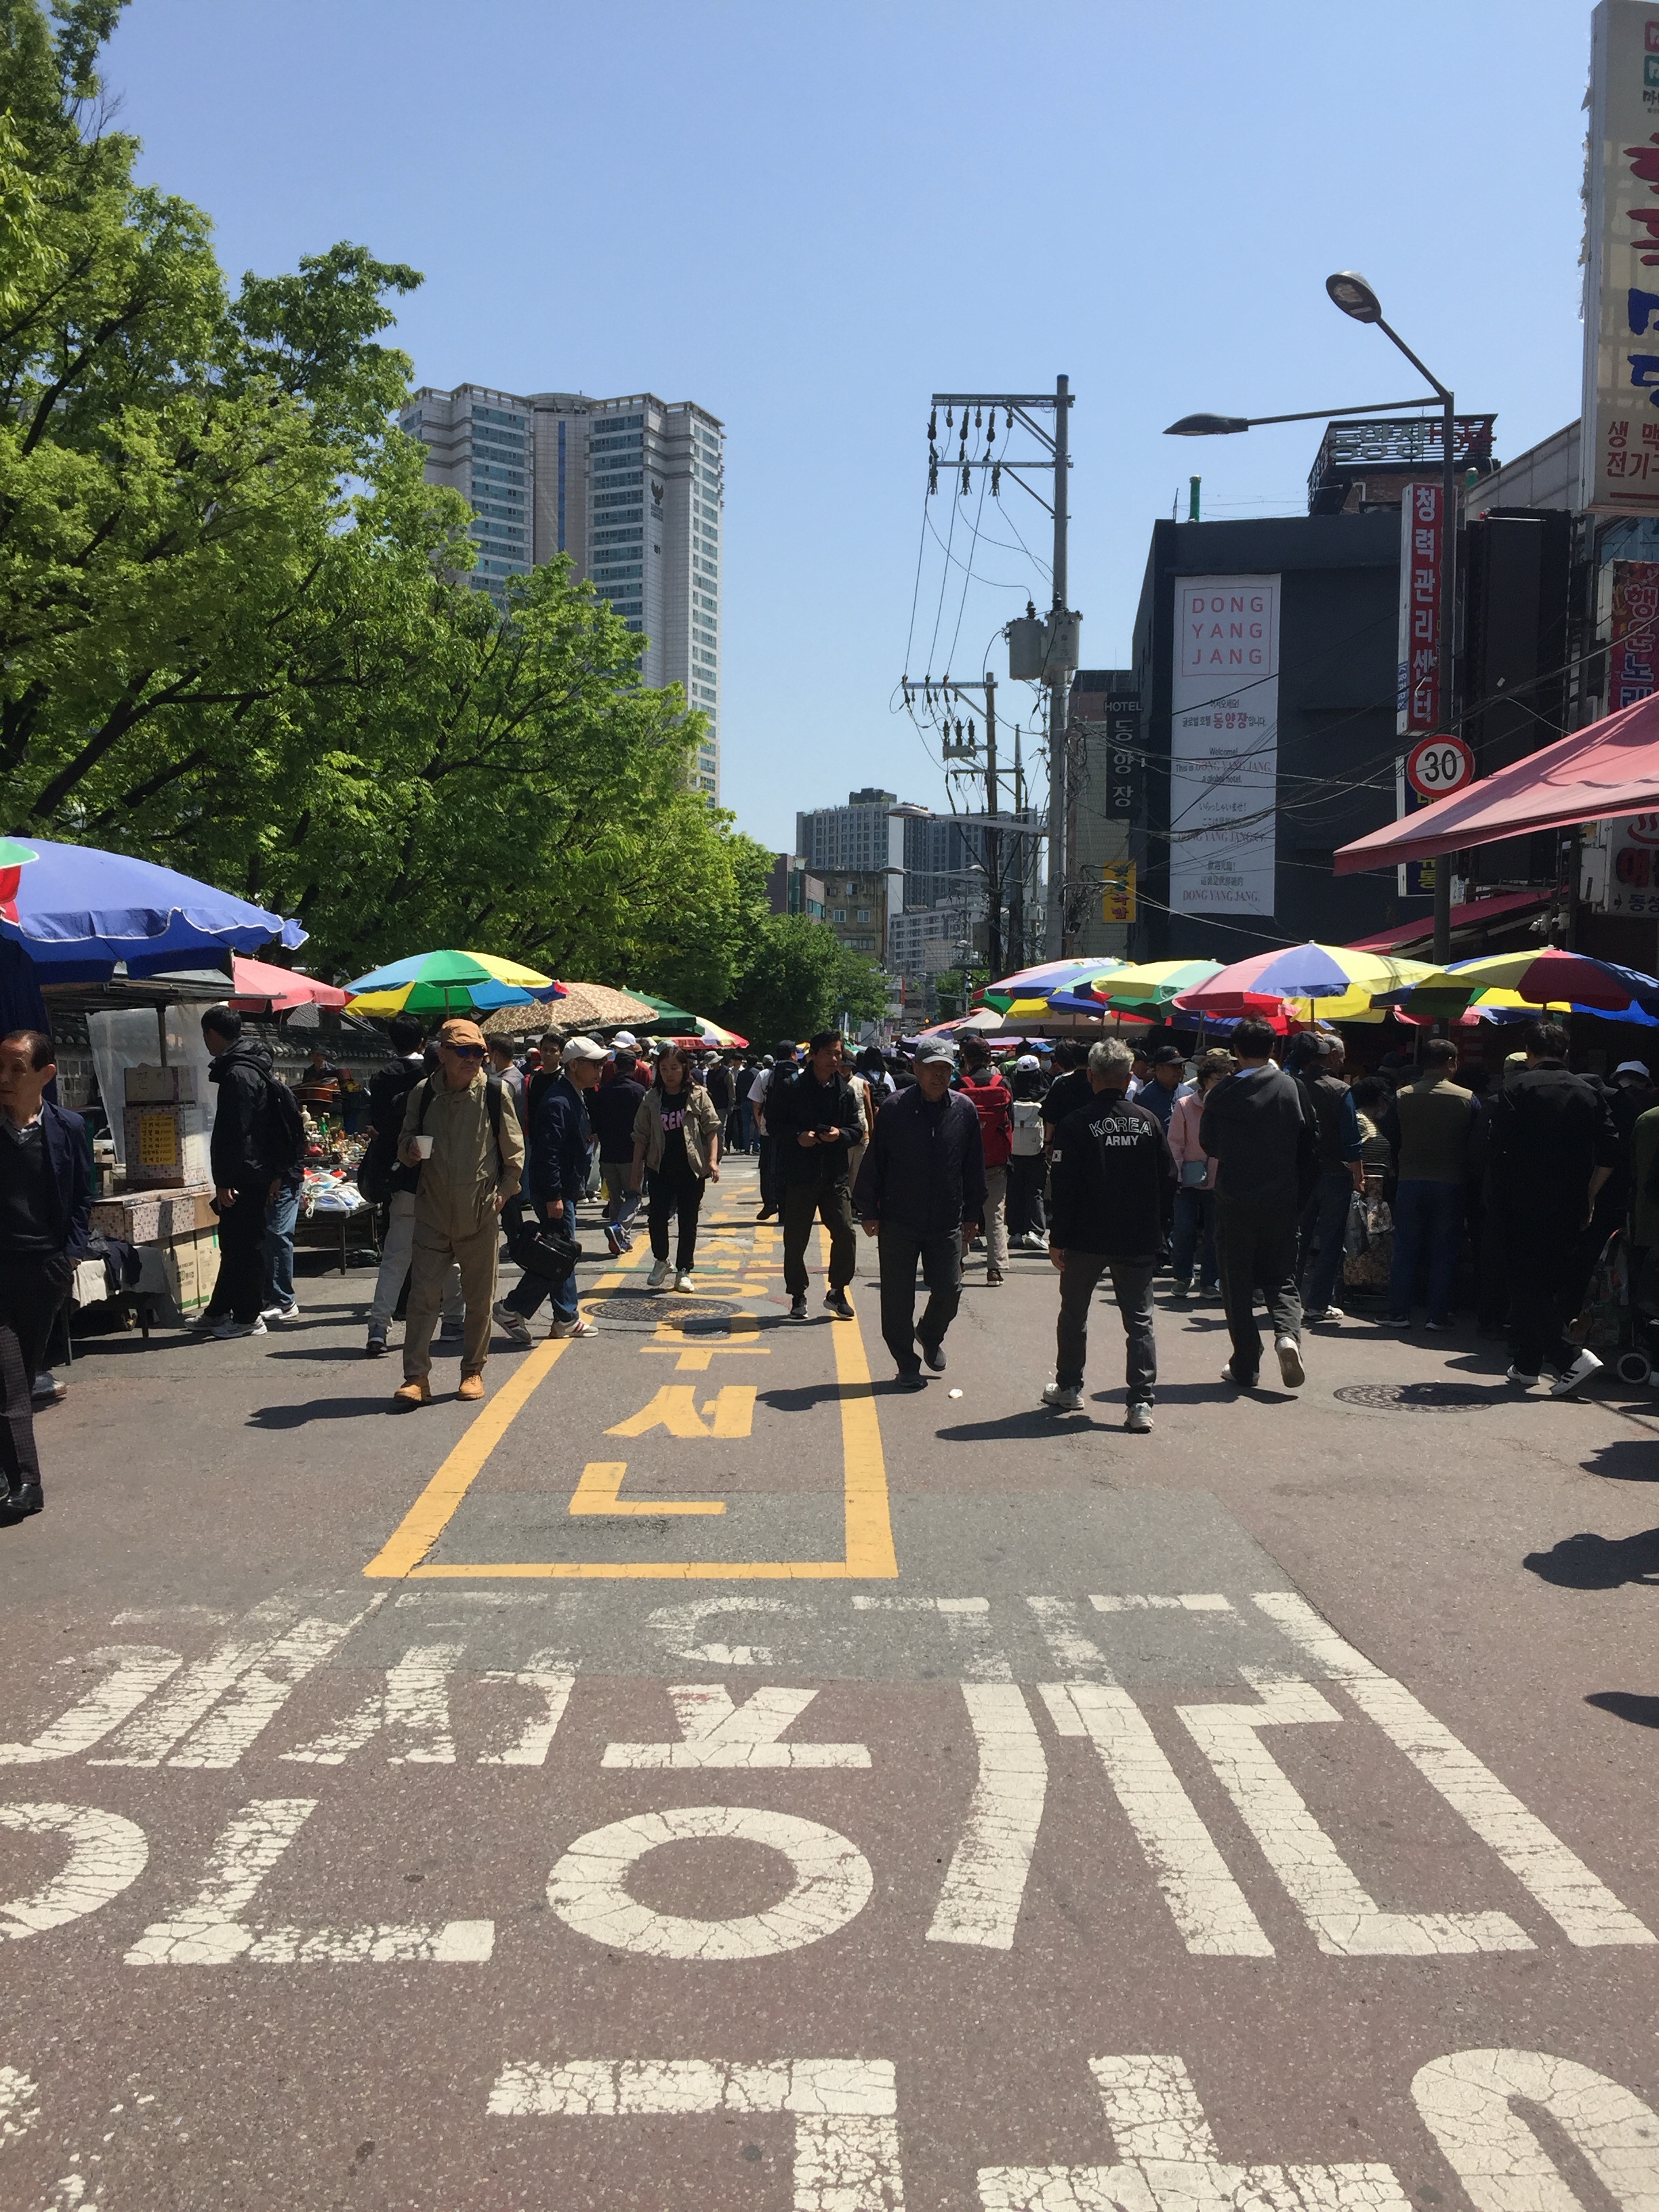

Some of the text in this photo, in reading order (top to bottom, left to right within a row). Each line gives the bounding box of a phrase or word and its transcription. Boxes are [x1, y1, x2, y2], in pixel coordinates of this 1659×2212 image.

[1328, 422, 1430, 462] 동양장
[1192, 596, 1263, 614] DONG
[1413, 487, 1435, 722] 청력관리센터
[1192, 622, 1263, 639] YANG
[1192, 648, 1262, 665] JANG
[1104, 701, 1143, 712] HOTEL
[1182, 716, 1199, 727] 글로벌
[1200, 715, 1211, 727] 호텔
[1209, 747, 1238, 756] Welcome!
[1112, 719, 1134, 807] 동양장
[1176, 764, 1188, 773] This
[1425, 750, 1457, 783] 30
[1616, 847, 1659, 889] 여
[1183, 889, 1208, 901] DONG
[1210, 890, 1233, 902] YANG
[1088, 1117, 1153, 1137] KOREA
[1105, 1134, 1139, 1147] ARMY
